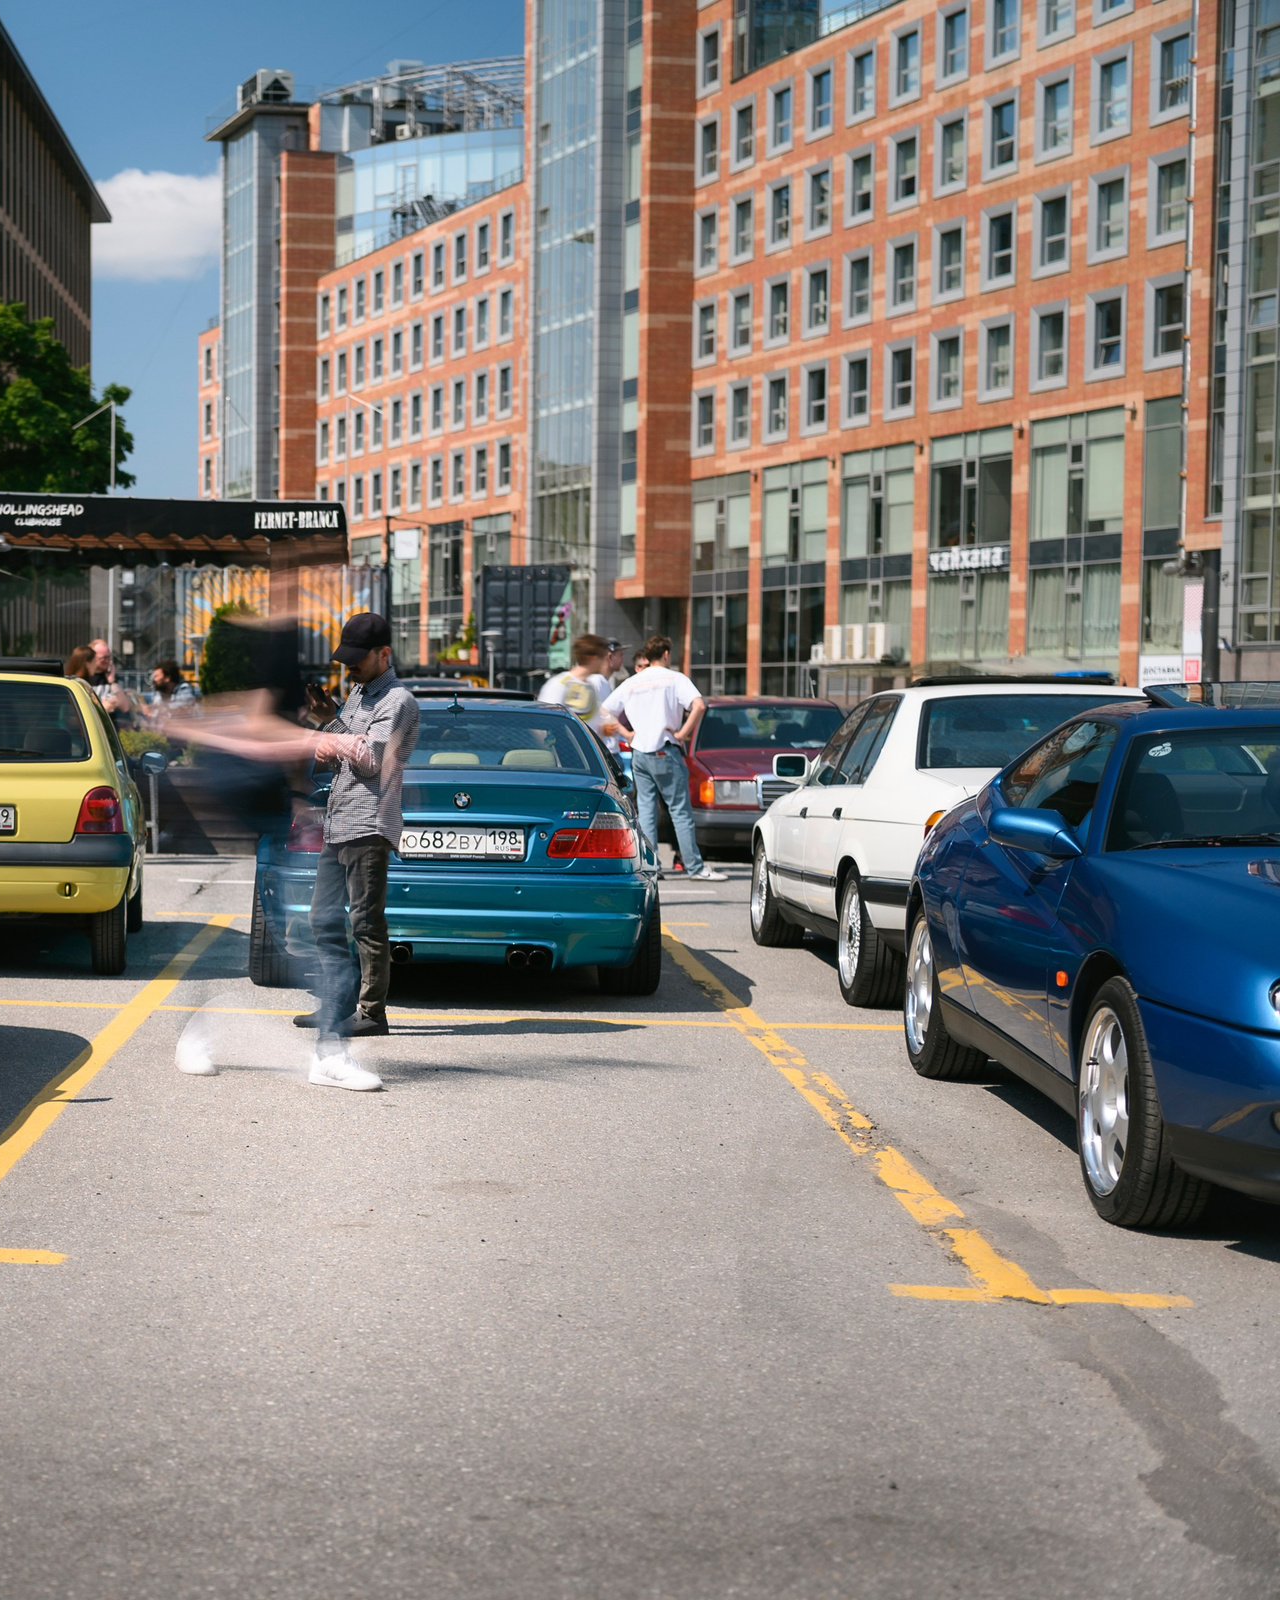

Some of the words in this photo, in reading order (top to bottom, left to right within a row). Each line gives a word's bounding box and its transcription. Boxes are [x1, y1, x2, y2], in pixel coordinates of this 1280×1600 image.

[14, 517, 62, 527] CLUBHOUSE
[254, 510, 339, 530] FERNET-BRANCA
[488, 830, 518, 845] 198
